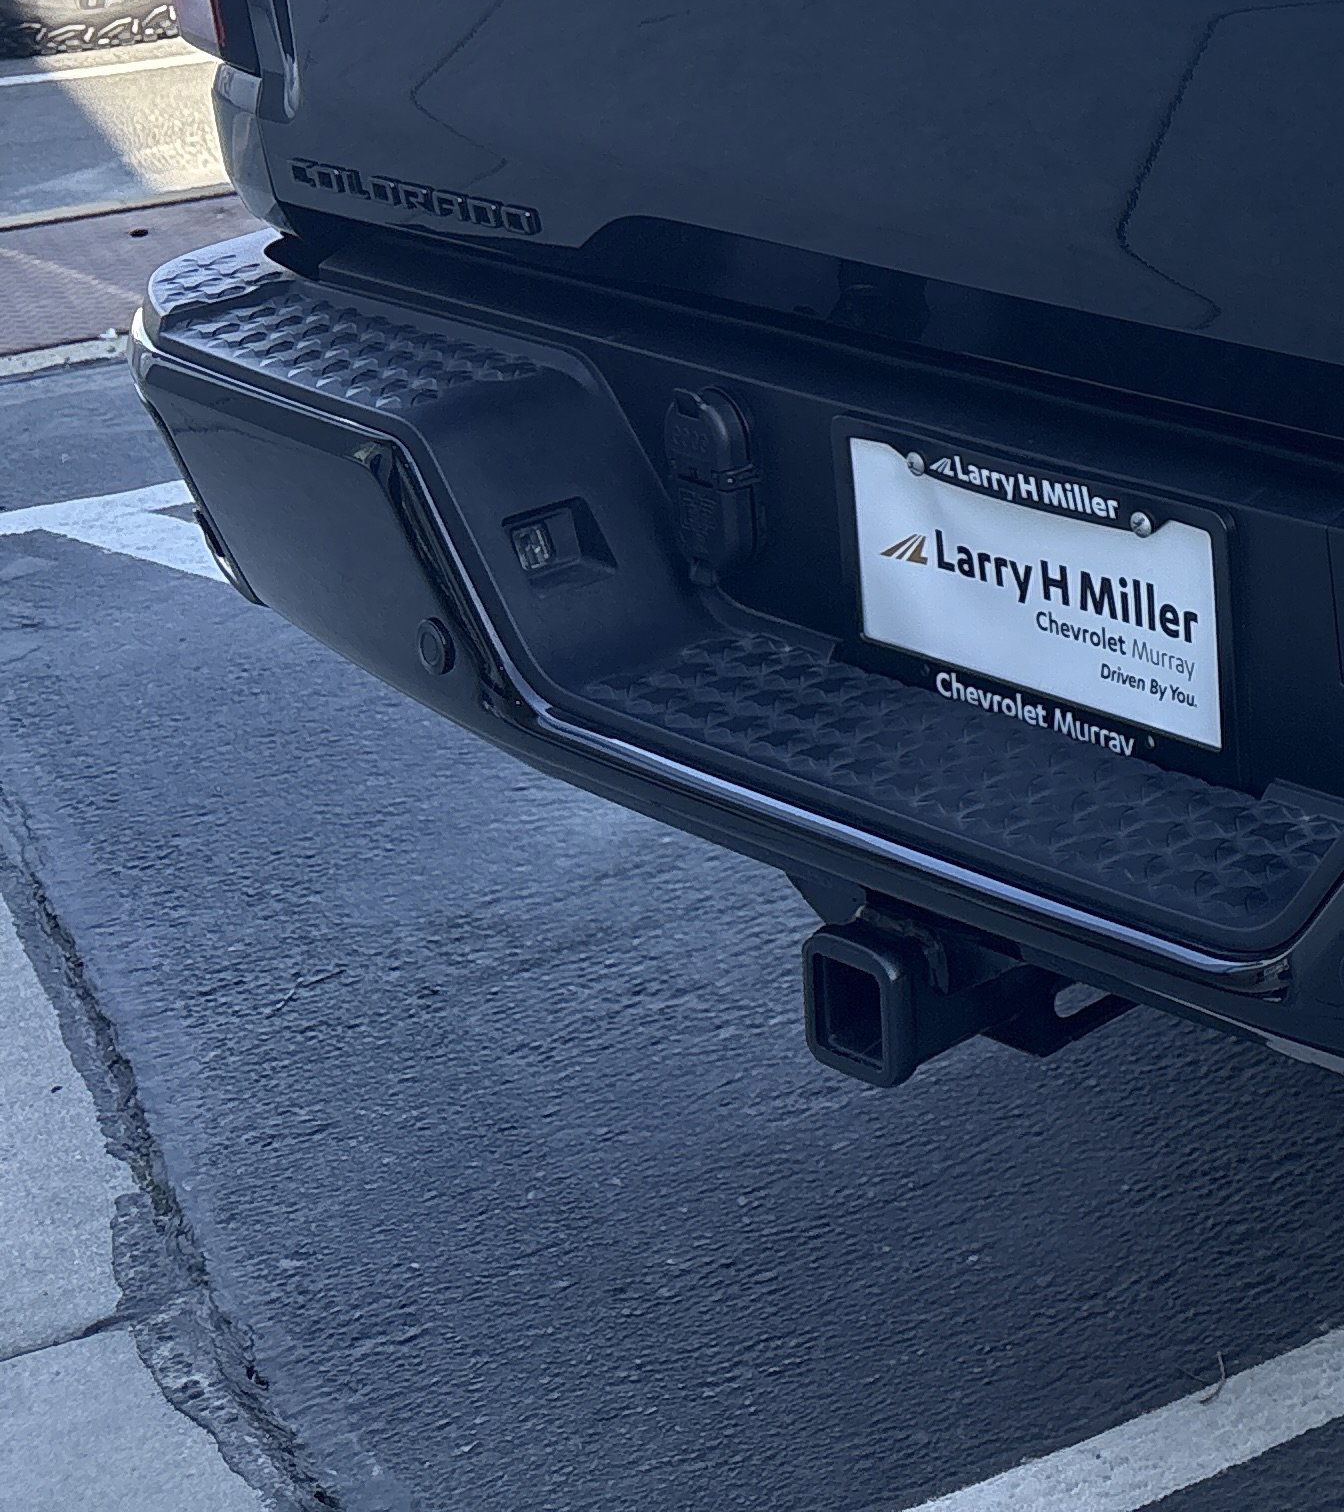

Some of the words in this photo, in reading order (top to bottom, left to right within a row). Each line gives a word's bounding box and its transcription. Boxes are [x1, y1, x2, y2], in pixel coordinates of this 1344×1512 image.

[288, 157, 543, 234] COLORADO
[953, 455, 1014, 500] Larry
[1019, 473, 1039, 503] H
[1042, 479, 1118, 520] Miller
[934, 528, 1032, 603] Larry
[1040, 559, 1070, 606] H
[1079, 570, 1198, 643] Miller
[1036, 611, 1126, 656] Chevrolet
[1132, 638, 1195, 681] Murray
[936, 671, 1048, 728] Chevrolet
[1054, 707, 1135, 756] Murray
[1101, 663, 1145, 692] Driven
[1150, 679, 1167, 701] By
[1170, 684, 1198, 708] You.
